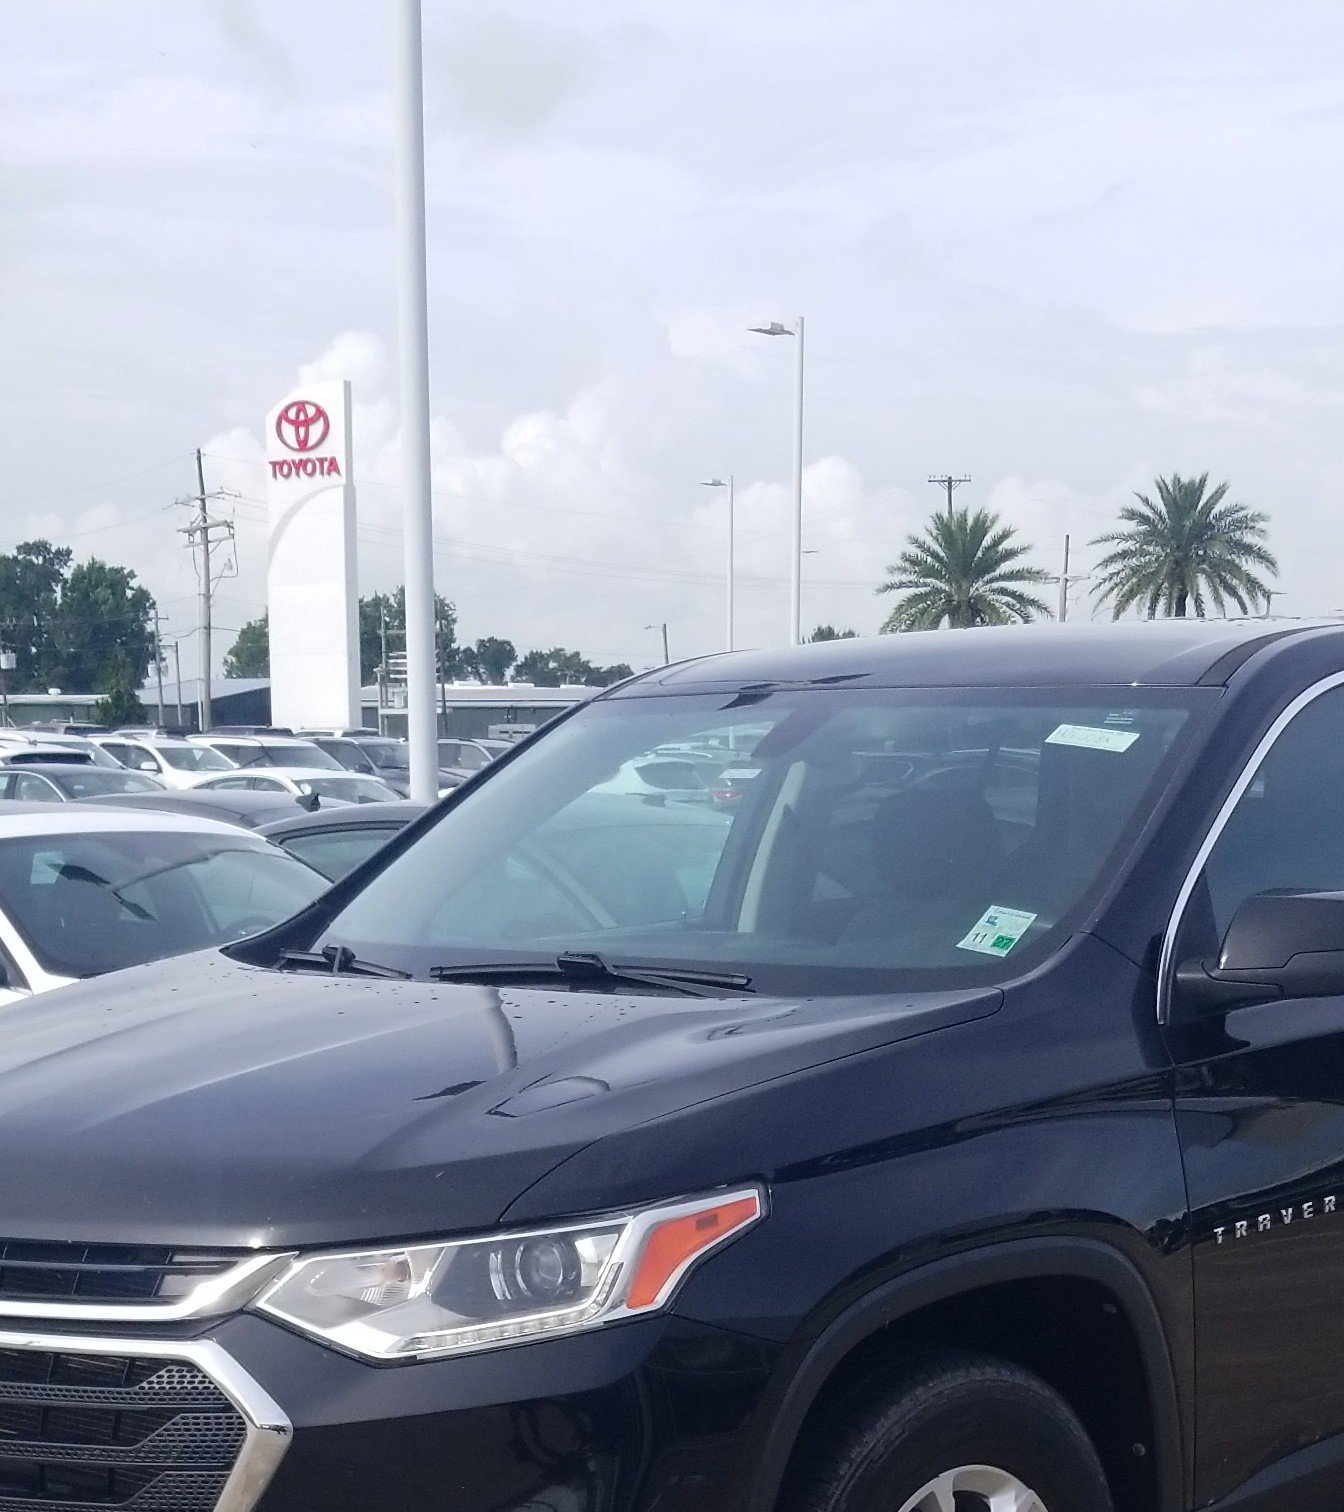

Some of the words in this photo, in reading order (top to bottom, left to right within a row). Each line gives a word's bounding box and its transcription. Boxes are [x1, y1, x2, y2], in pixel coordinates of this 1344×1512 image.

[269, 456, 341, 480] TOYOTA
[972, 932, 987, 943] 11
[991, 936, 1013, 948] 27
